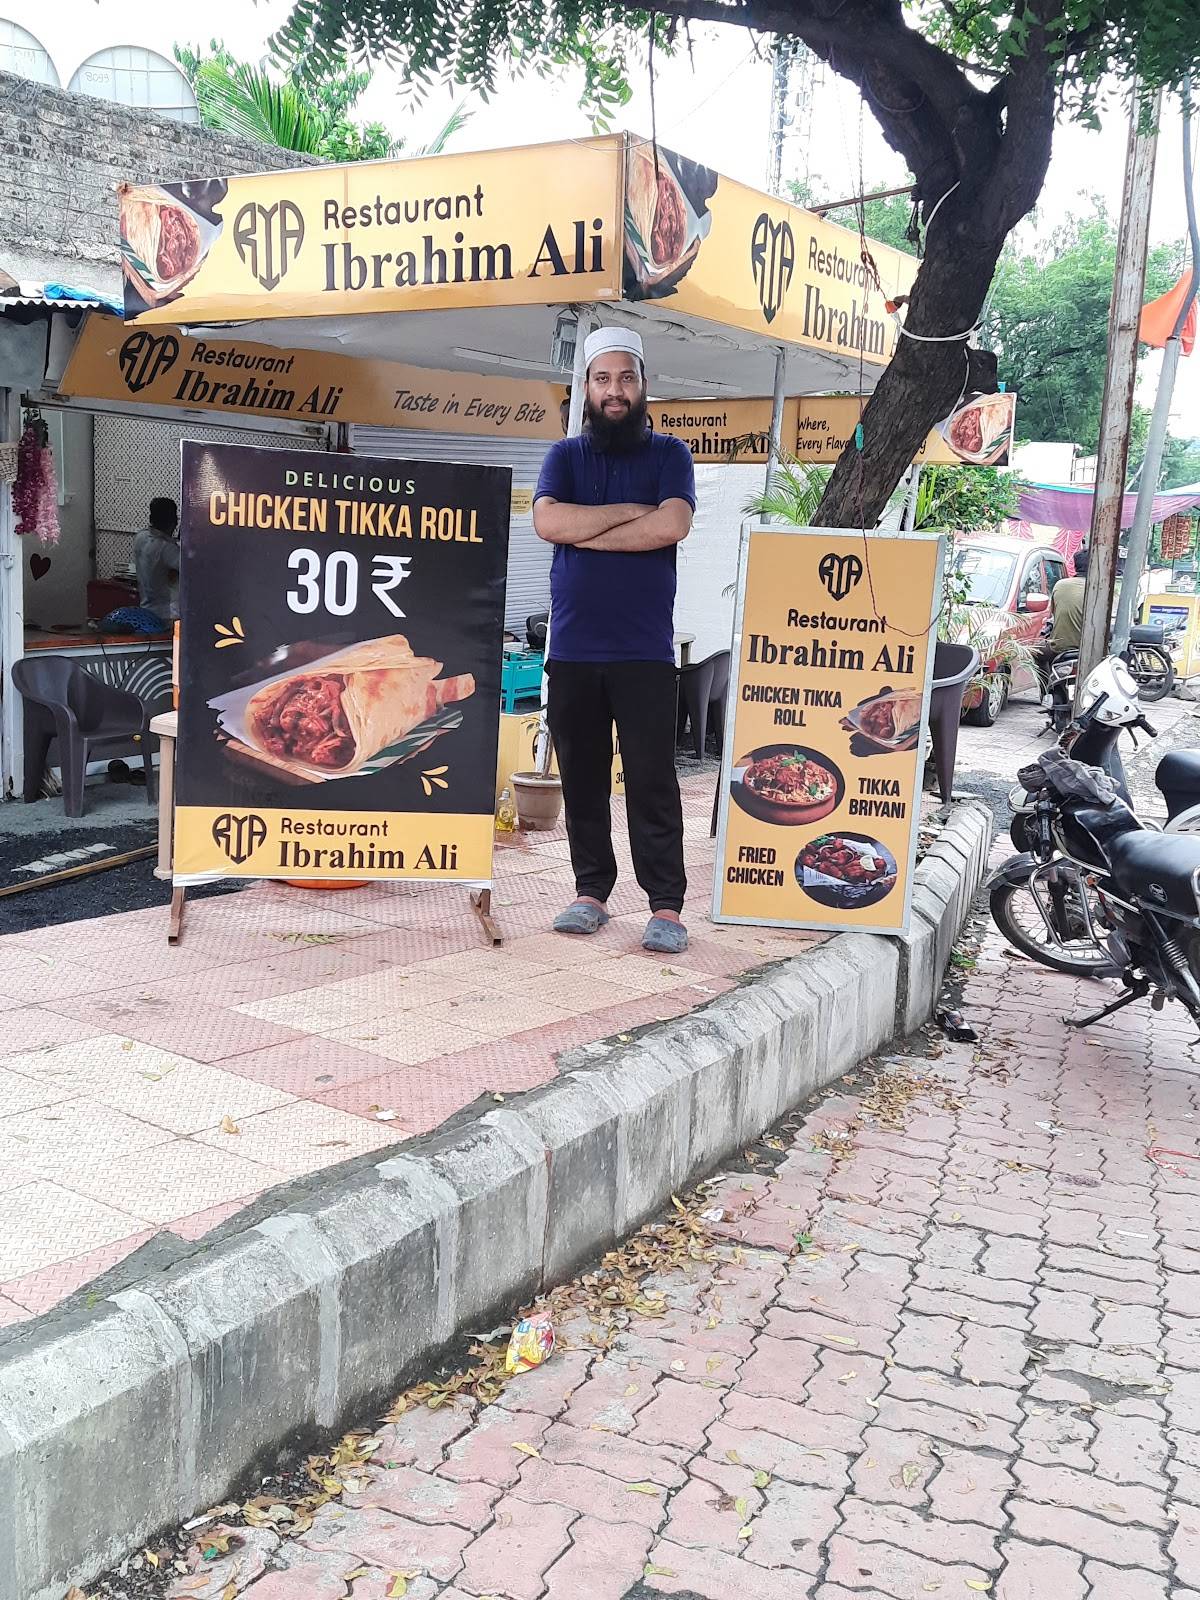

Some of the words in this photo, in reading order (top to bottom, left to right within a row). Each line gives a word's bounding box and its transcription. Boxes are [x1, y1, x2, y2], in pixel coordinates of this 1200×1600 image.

[324, 185, 484, 230] Restaurant
[322, 231, 515, 292] Ibrahim
[526, 218, 606, 278] Ali
[801, 283, 885, 356] Ibrahim
[190, 343, 295, 375] Restaurant
[174, 368, 302, 414] Ibrahim
[300, 384, 345, 415] Ali
[394, 391, 441, 414] Taste
[443, 394, 460, 414] in
[464, 399, 512, 426] Every
[513, 402, 546, 423] Bite
[661, 412, 727, 428] Restaurant
[796, 417, 830, 433] Where,
[796, 437, 824, 454] Every
[284, 470, 415, 494] DELICIOUS
[209, 490, 328, 532] CHICKEN
[335, 499, 413, 539] TIKKA
[421, 507, 484, 543] ROLL
[287, 548, 359, 615] 30
[787, 609, 887, 634] Restaurant
[747, 634, 865, 671] Ibrahim
[871, 643, 914, 674] Ali
[742, 685, 801, 706] CHICKEN
[803, 688, 842, 709] TIKKA
[774, 708, 807, 727] ROLL
[858, 777, 900, 797] TIKKA
[848, 798, 906, 819] BRIYANI
[281, 818, 389, 837] Restaurant
[278, 841, 405, 869] Ibrahim
[413, 844, 458, 869] Ali
[739, 846, 777, 865] FRIED
[726, 867, 784, 887] CHICKEN
